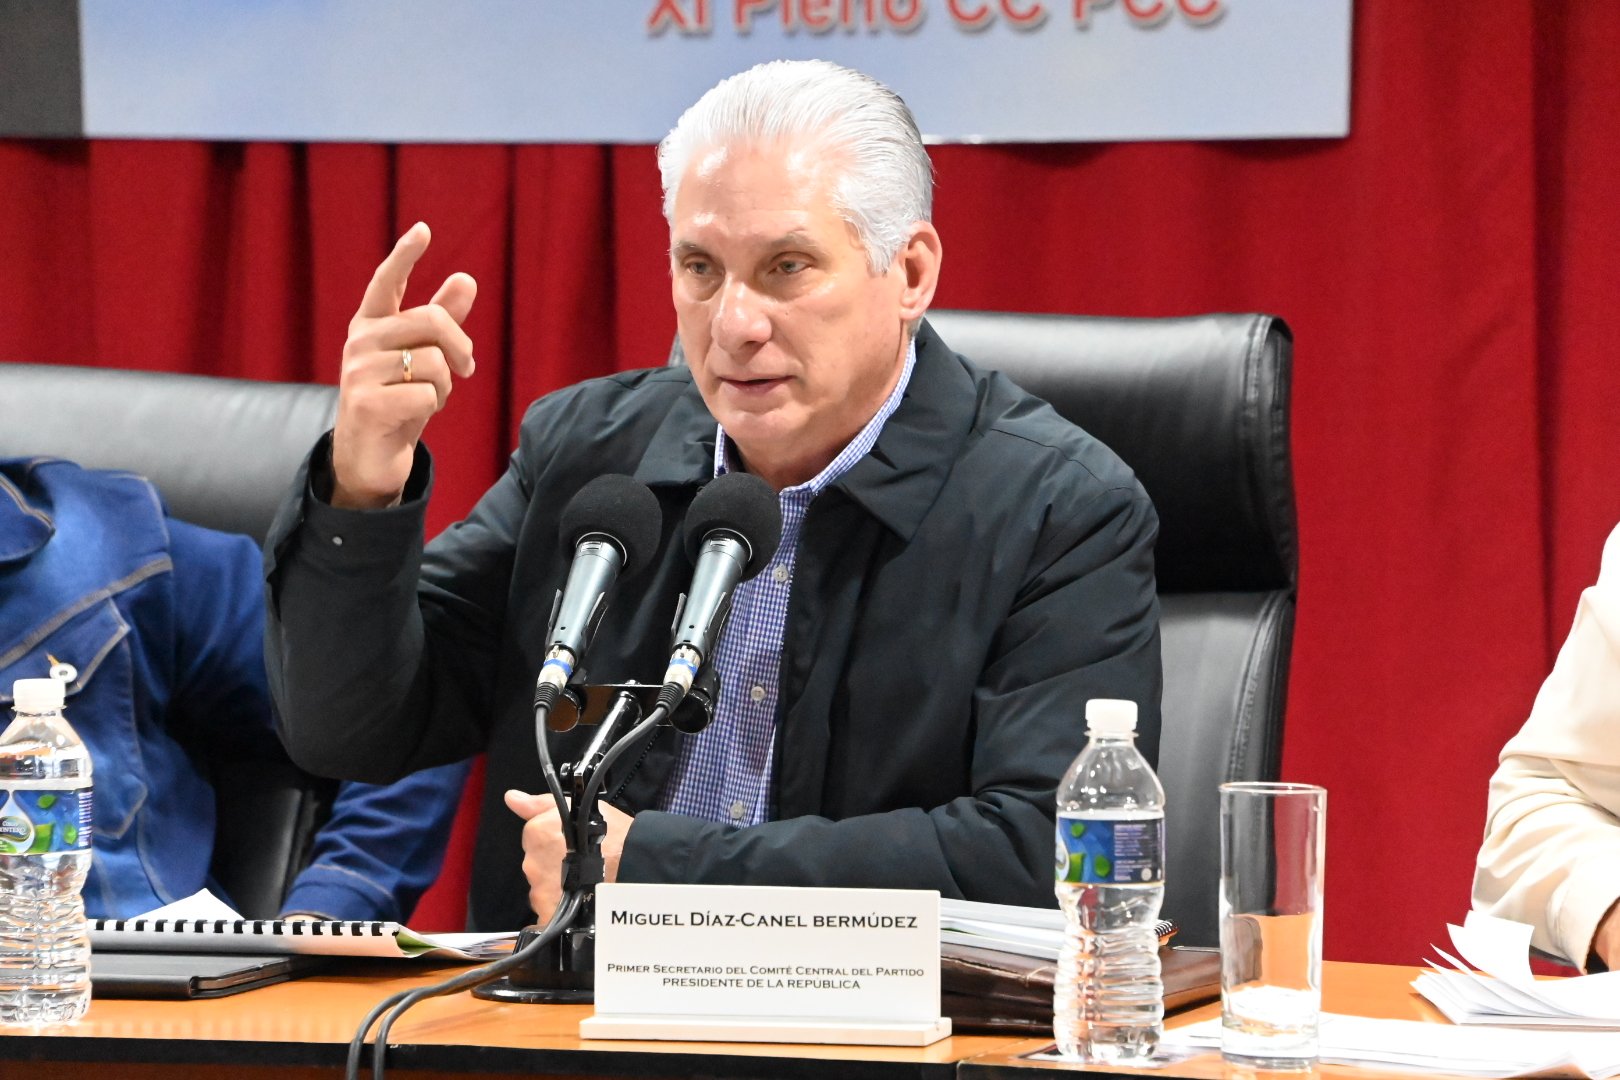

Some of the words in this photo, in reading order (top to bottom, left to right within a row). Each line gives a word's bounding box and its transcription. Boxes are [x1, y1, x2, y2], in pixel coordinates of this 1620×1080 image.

[611, 910, 685, 926] MIGUEL
[690, 910, 808, 928] DÍAZ-CANEL
[813, 911, 918, 929] BERMÚDEZ
[607, 963, 650, 973] PRIMER
[653, 964, 723, 974] SECRETARIO
[726, 966, 747, 975] DEL
[750, 964, 792, 975] COMITÉ
[795, 966, 849, 976] CENTRAL
[851, 968, 873, 976] DEL
[876, 967, 925, 977] PARTIDO
[663, 977, 743, 988] PRESIDENTE
[747, 979, 764, 988] DE
[767, 979, 784, 988] LA
[787, 977, 861, 989] REPÚBLICA
